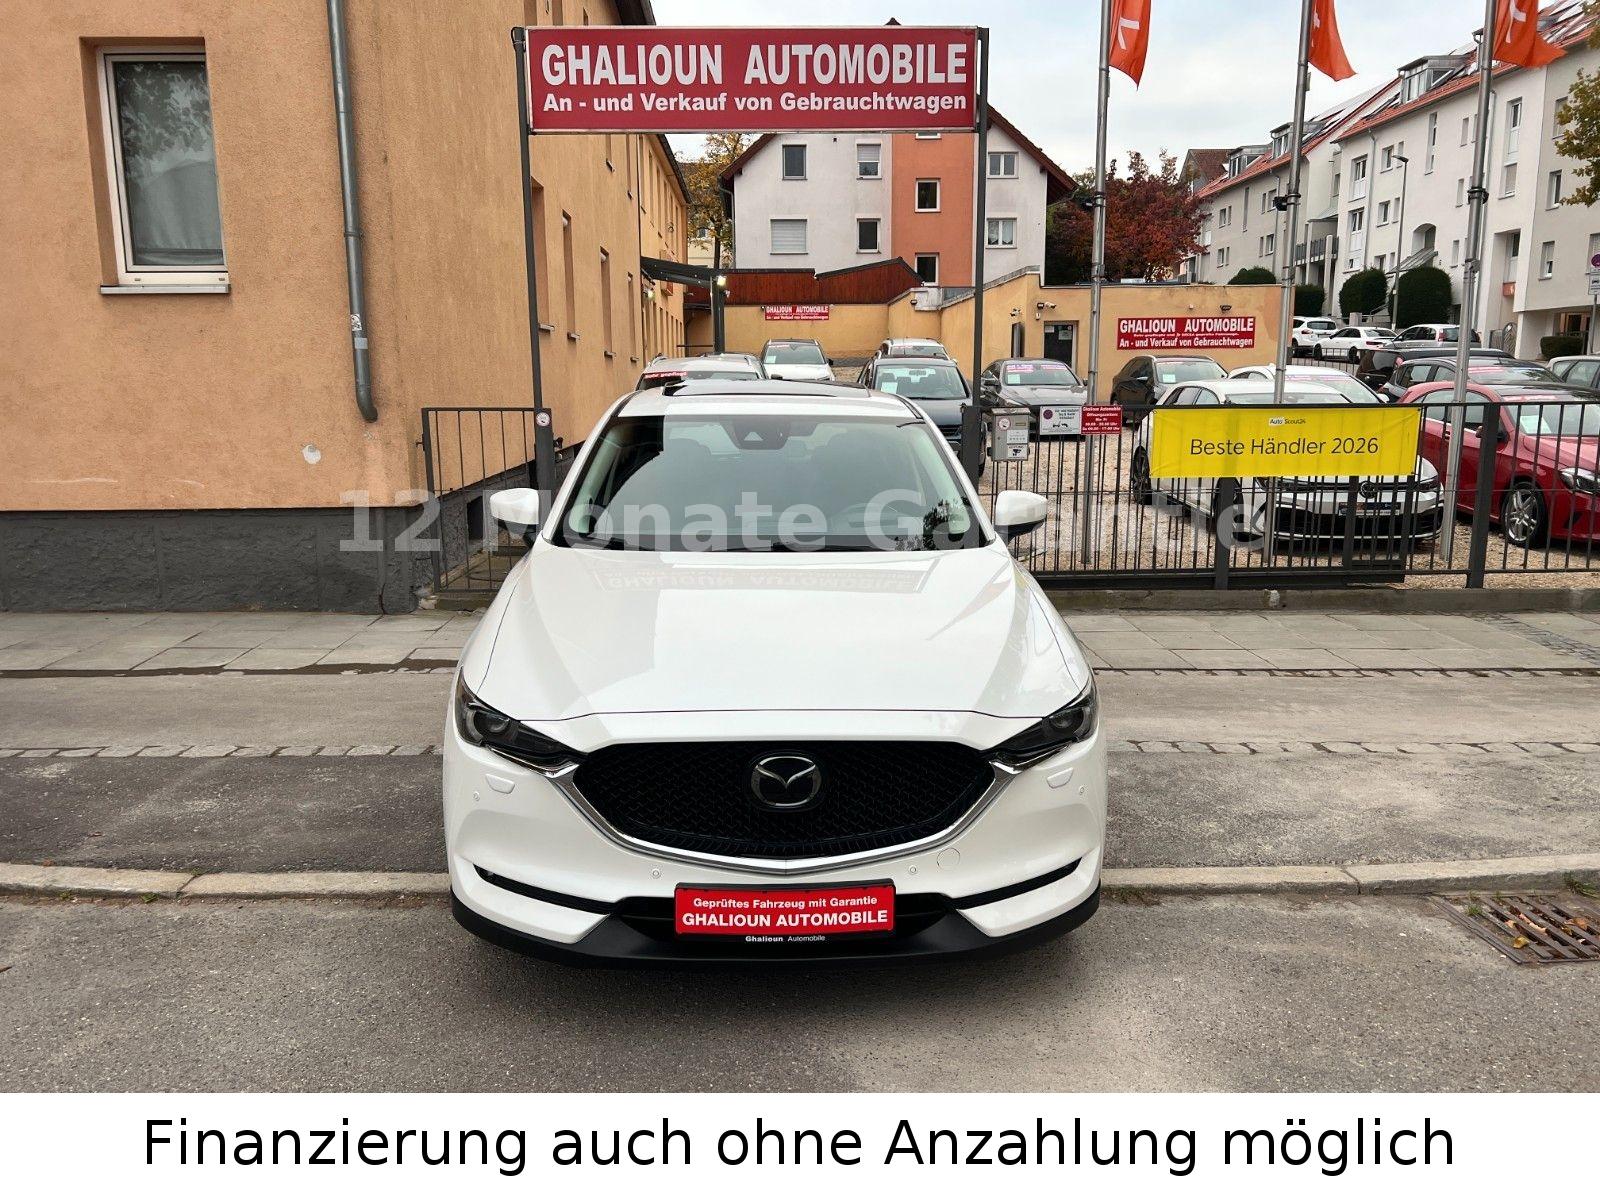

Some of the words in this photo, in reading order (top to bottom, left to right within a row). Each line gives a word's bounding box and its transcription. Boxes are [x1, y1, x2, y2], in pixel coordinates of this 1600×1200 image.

[542, 44, 723, 86] GHALIOUN
[743, 43, 967, 85] AUTOMOBILE
[543, 93, 572, 112] An
[593, 93, 633, 112] und
[640, 92, 728, 111] Verkauf
[734, 97, 773, 111] von
[780, 92, 967, 114] Gebrauchtwagen
[766, 305, 792, 313] GHALIOUN
[796, 305, 829, 313] AUTOMOBILE
[1120, 319, 1176, 334] GHALIOUN
[1184, 318, 1254, 333] AUTOMOBILE
[1119, 338, 1129, 348] An
[1135, 338, 1149, 347] und
[1150, 337, 1179, 347] Verkauf
[1180, 339, 1192, 347] von
[1194, 336, 1253, 348] Gebrauchtwagen
[1190, 438, 1244, 455] Beste
[1251, 437, 1326, 455] Händler
[1331, 437, 1379, 454] 2026
[693, 897, 749, 910] Geprüftes
[752, 898, 805, 910] Fahrzeug
[808, 897, 827, 908] mit
[829, 896, 878, 907] Garantie
[682, 913, 771, 927] GHALIOUN
[775, 910, 888, 927] AUTOMOBILE
[745, 935, 784, 943] Ghalioun
[787, 934, 826, 943] Automobile
